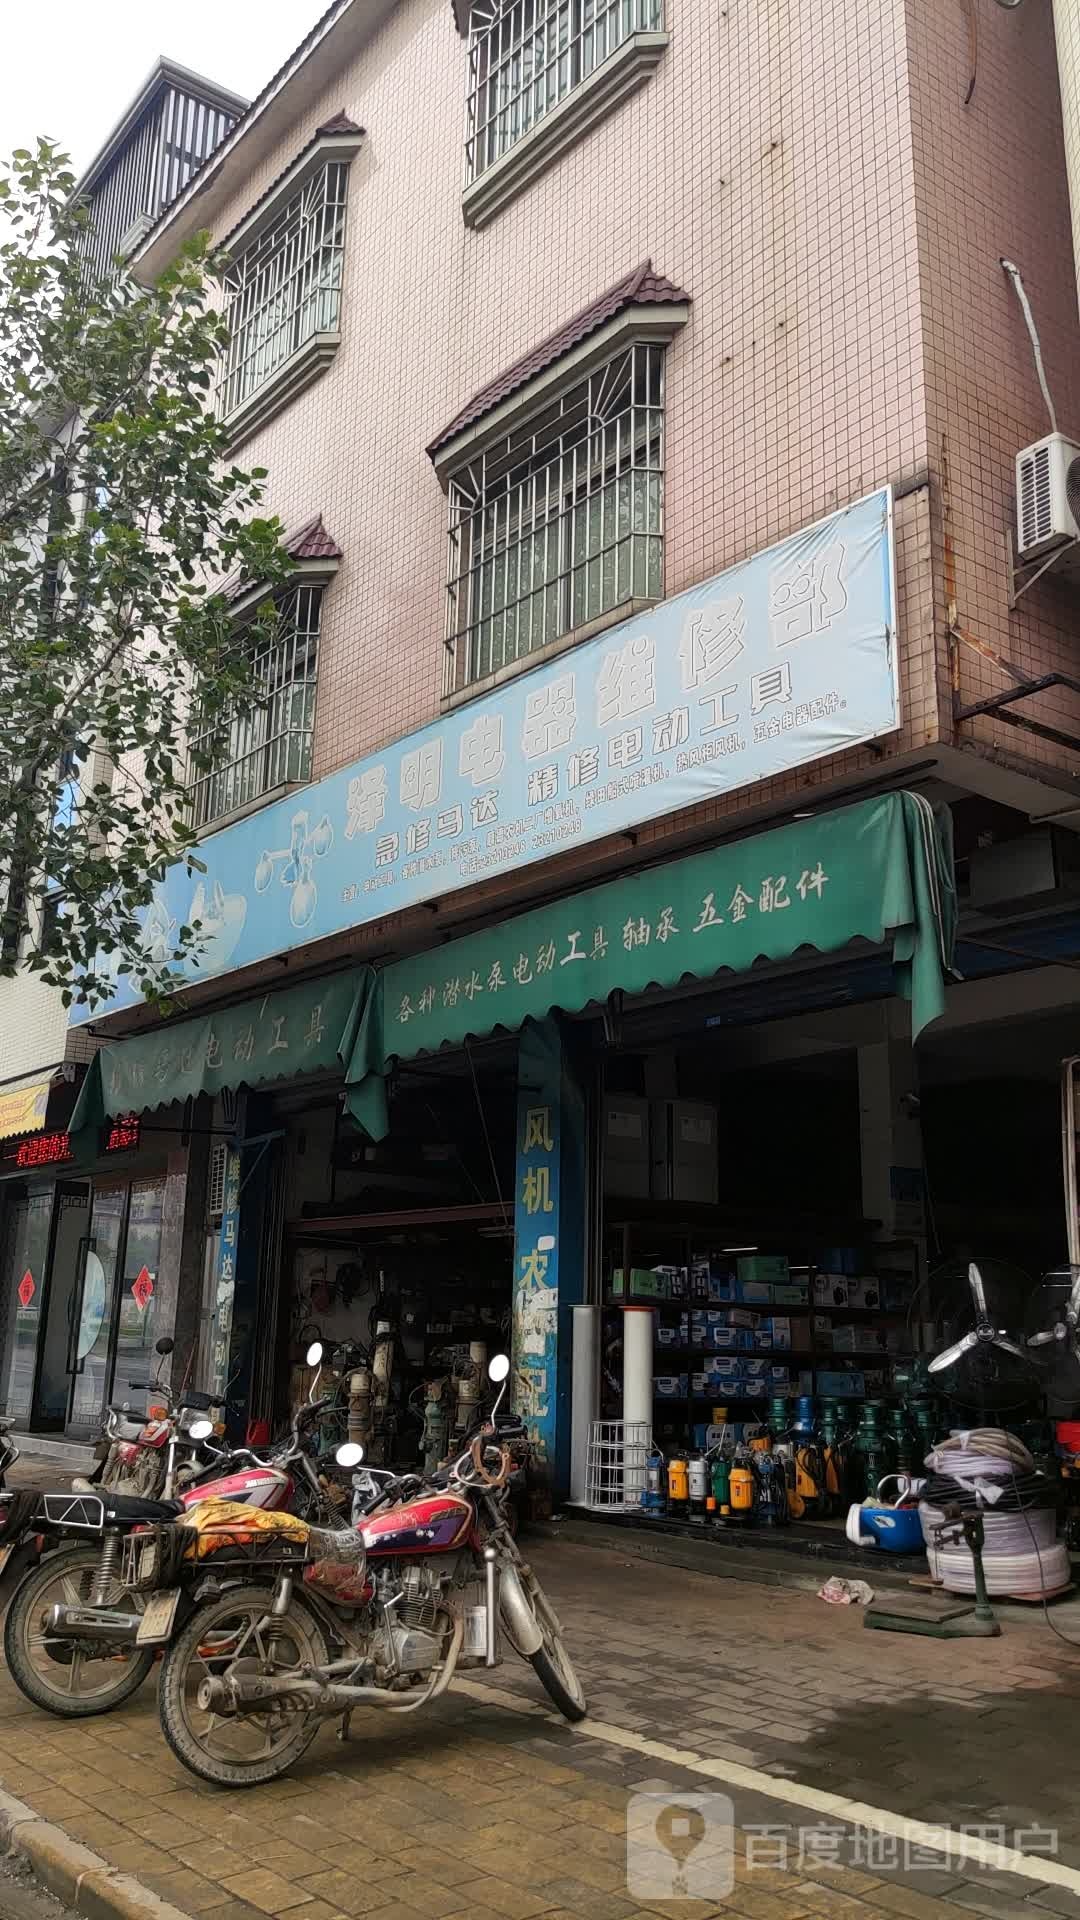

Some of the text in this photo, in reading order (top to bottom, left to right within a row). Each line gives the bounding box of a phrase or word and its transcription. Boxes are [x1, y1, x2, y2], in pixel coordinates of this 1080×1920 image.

[343, 540, 849, 841] 泽明电器维修部
[375, 661, 793, 868] 急修马达 精修电动工具
[622, 905, 680, 952] 轴承
[692, 861, 829, 934] 五金配件
[522, 1106, 554, 1216] 风机
